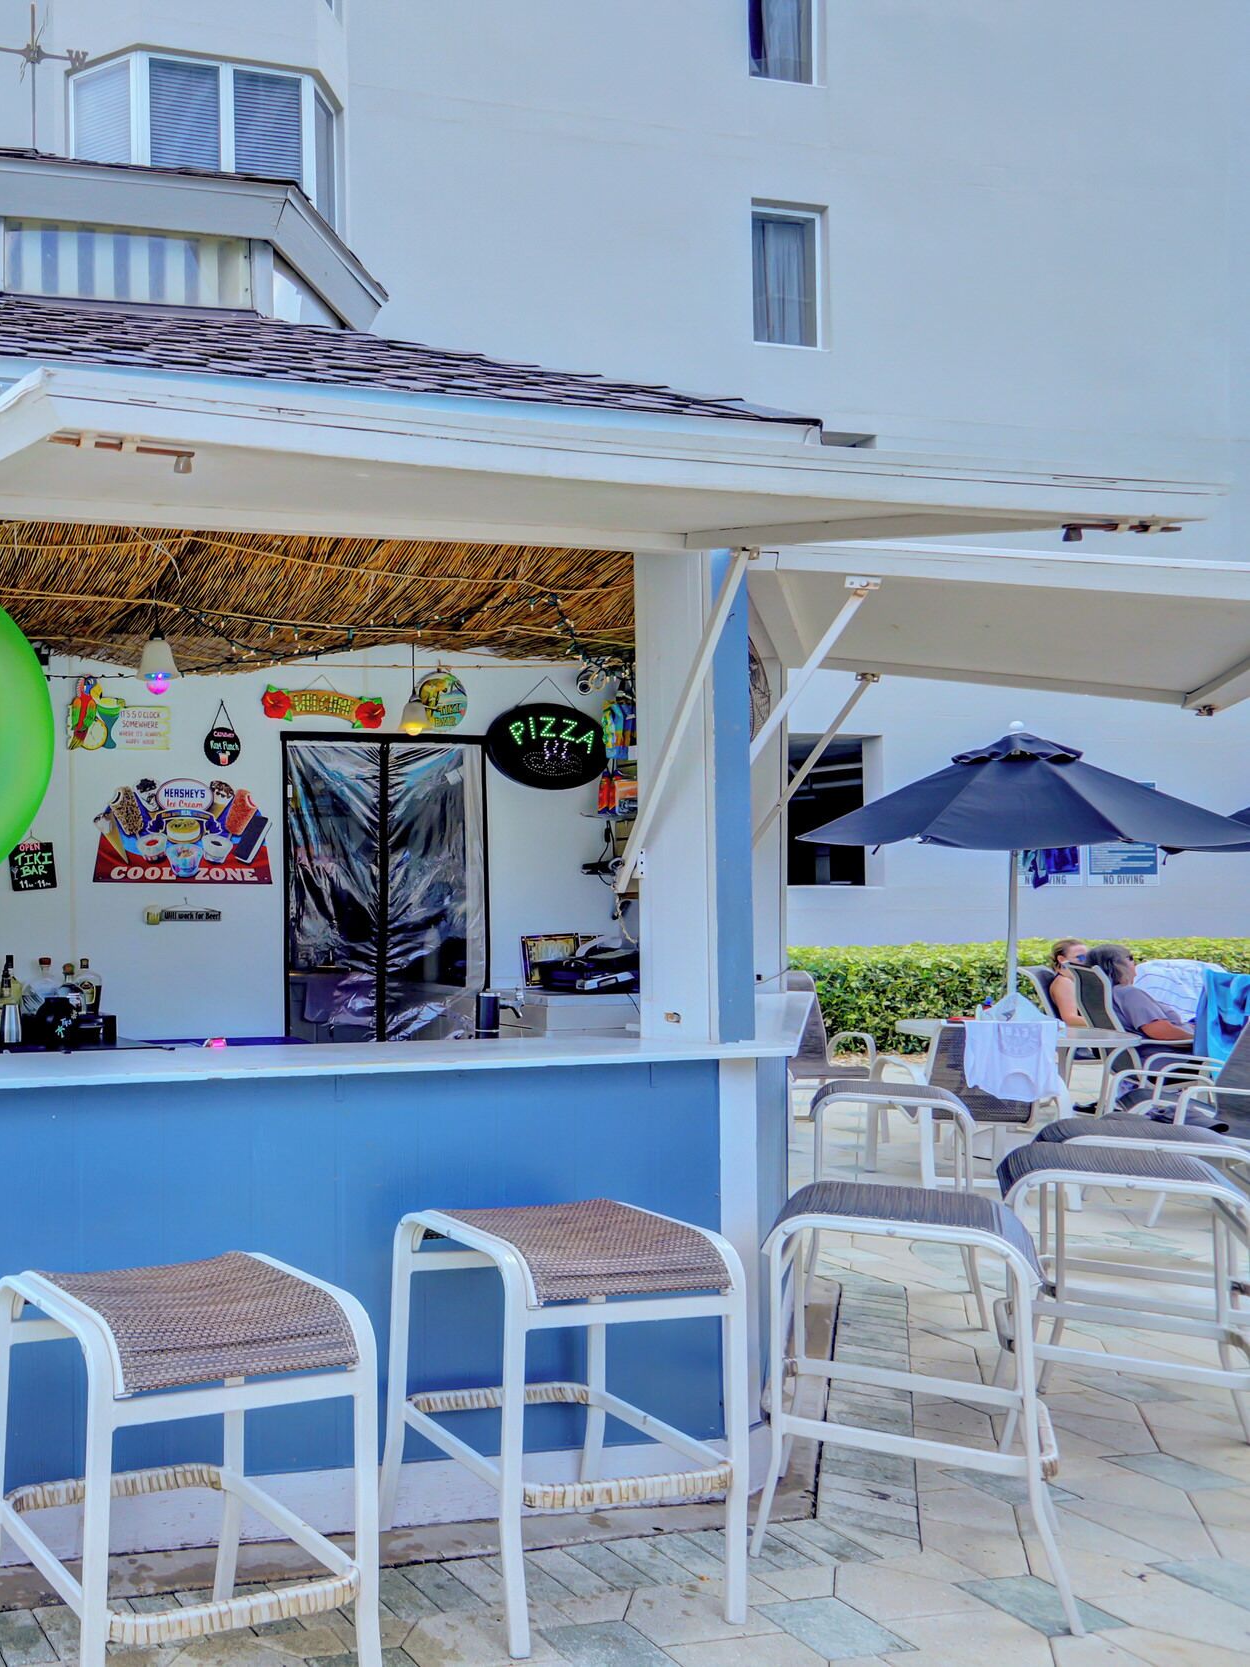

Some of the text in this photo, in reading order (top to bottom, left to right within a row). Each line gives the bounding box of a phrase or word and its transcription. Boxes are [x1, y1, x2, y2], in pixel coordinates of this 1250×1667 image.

[122, 720, 159, 728] SOMEWHERE
[509, 716, 595, 755] PIZZA
[179, 799, 203, 808] Cream
[19, 843, 40, 851] OPEN
[14, 852, 52, 865] TIKI
[20, 865, 47, 877] BAR
[110, 866, 259, 881] COOL ZONE
[1103, 875, 1145, 885] NO DIVING
[164, 911, 177, 920] Will
